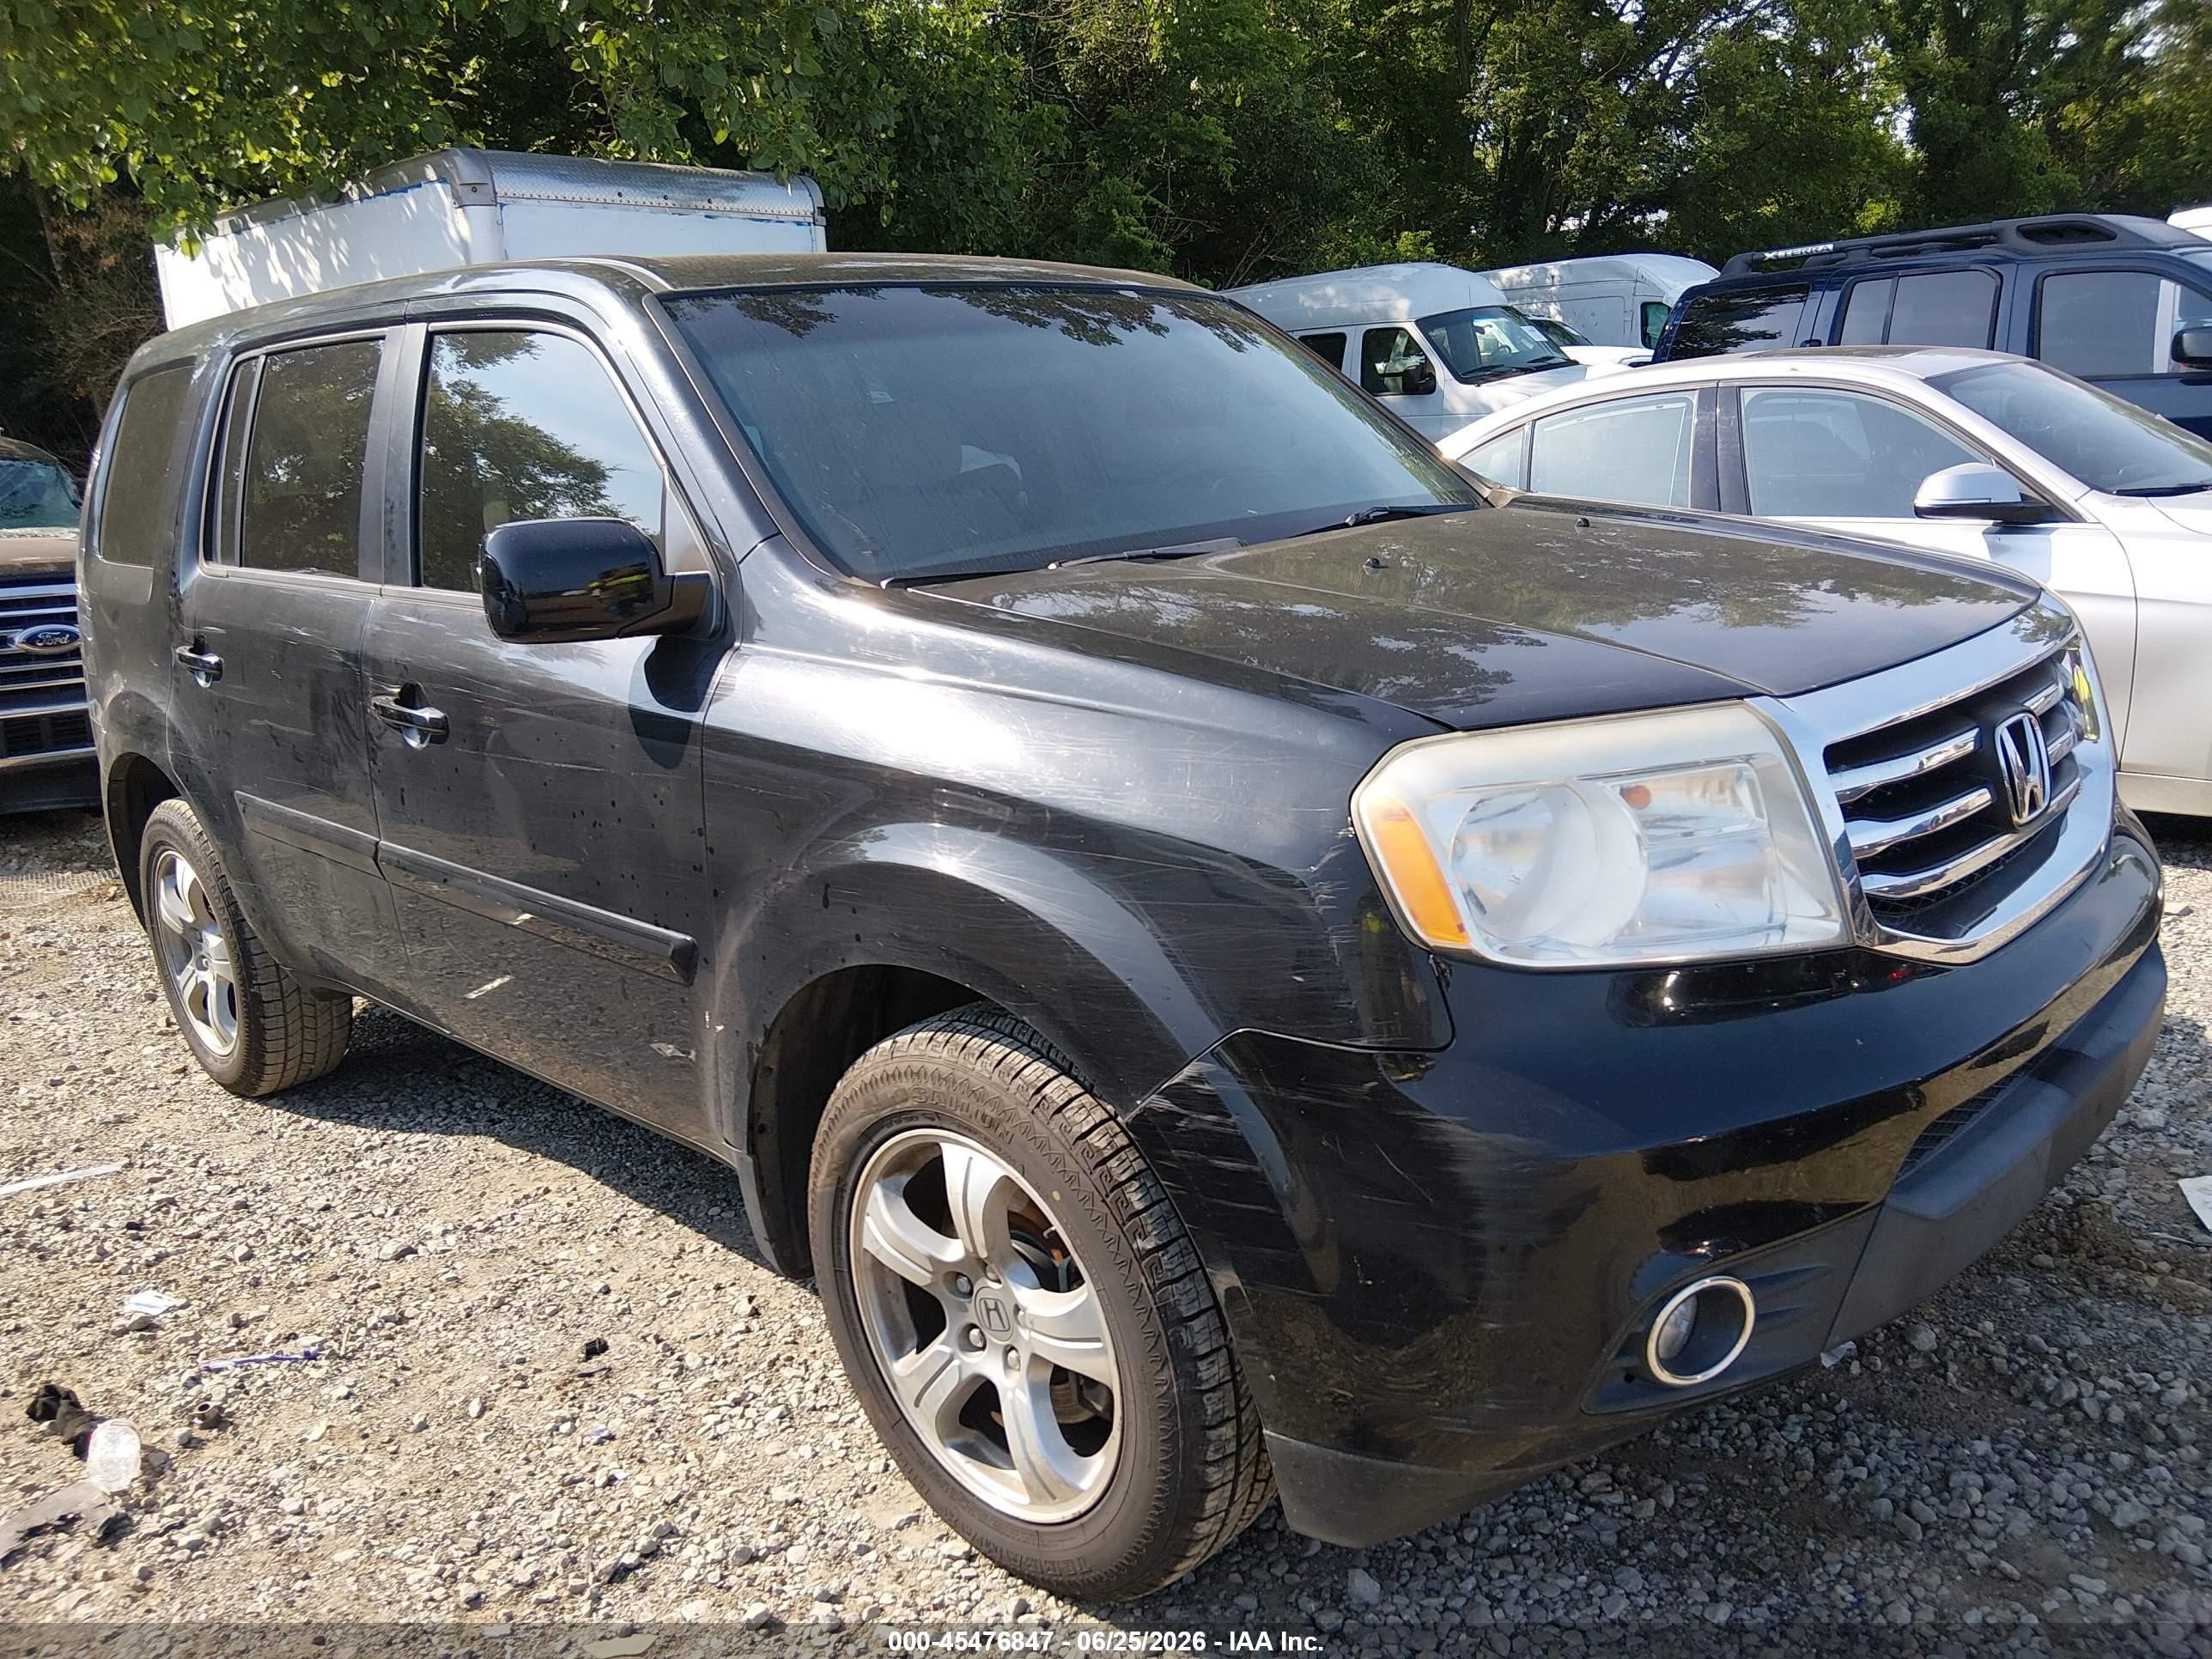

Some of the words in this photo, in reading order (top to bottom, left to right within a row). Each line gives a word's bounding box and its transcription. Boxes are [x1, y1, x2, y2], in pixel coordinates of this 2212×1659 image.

[1763, 244, 1833, 261] XTERRA
[35, 631, 70, 647] Ford
[912, 1086, 1016, 1145] SAILUN
